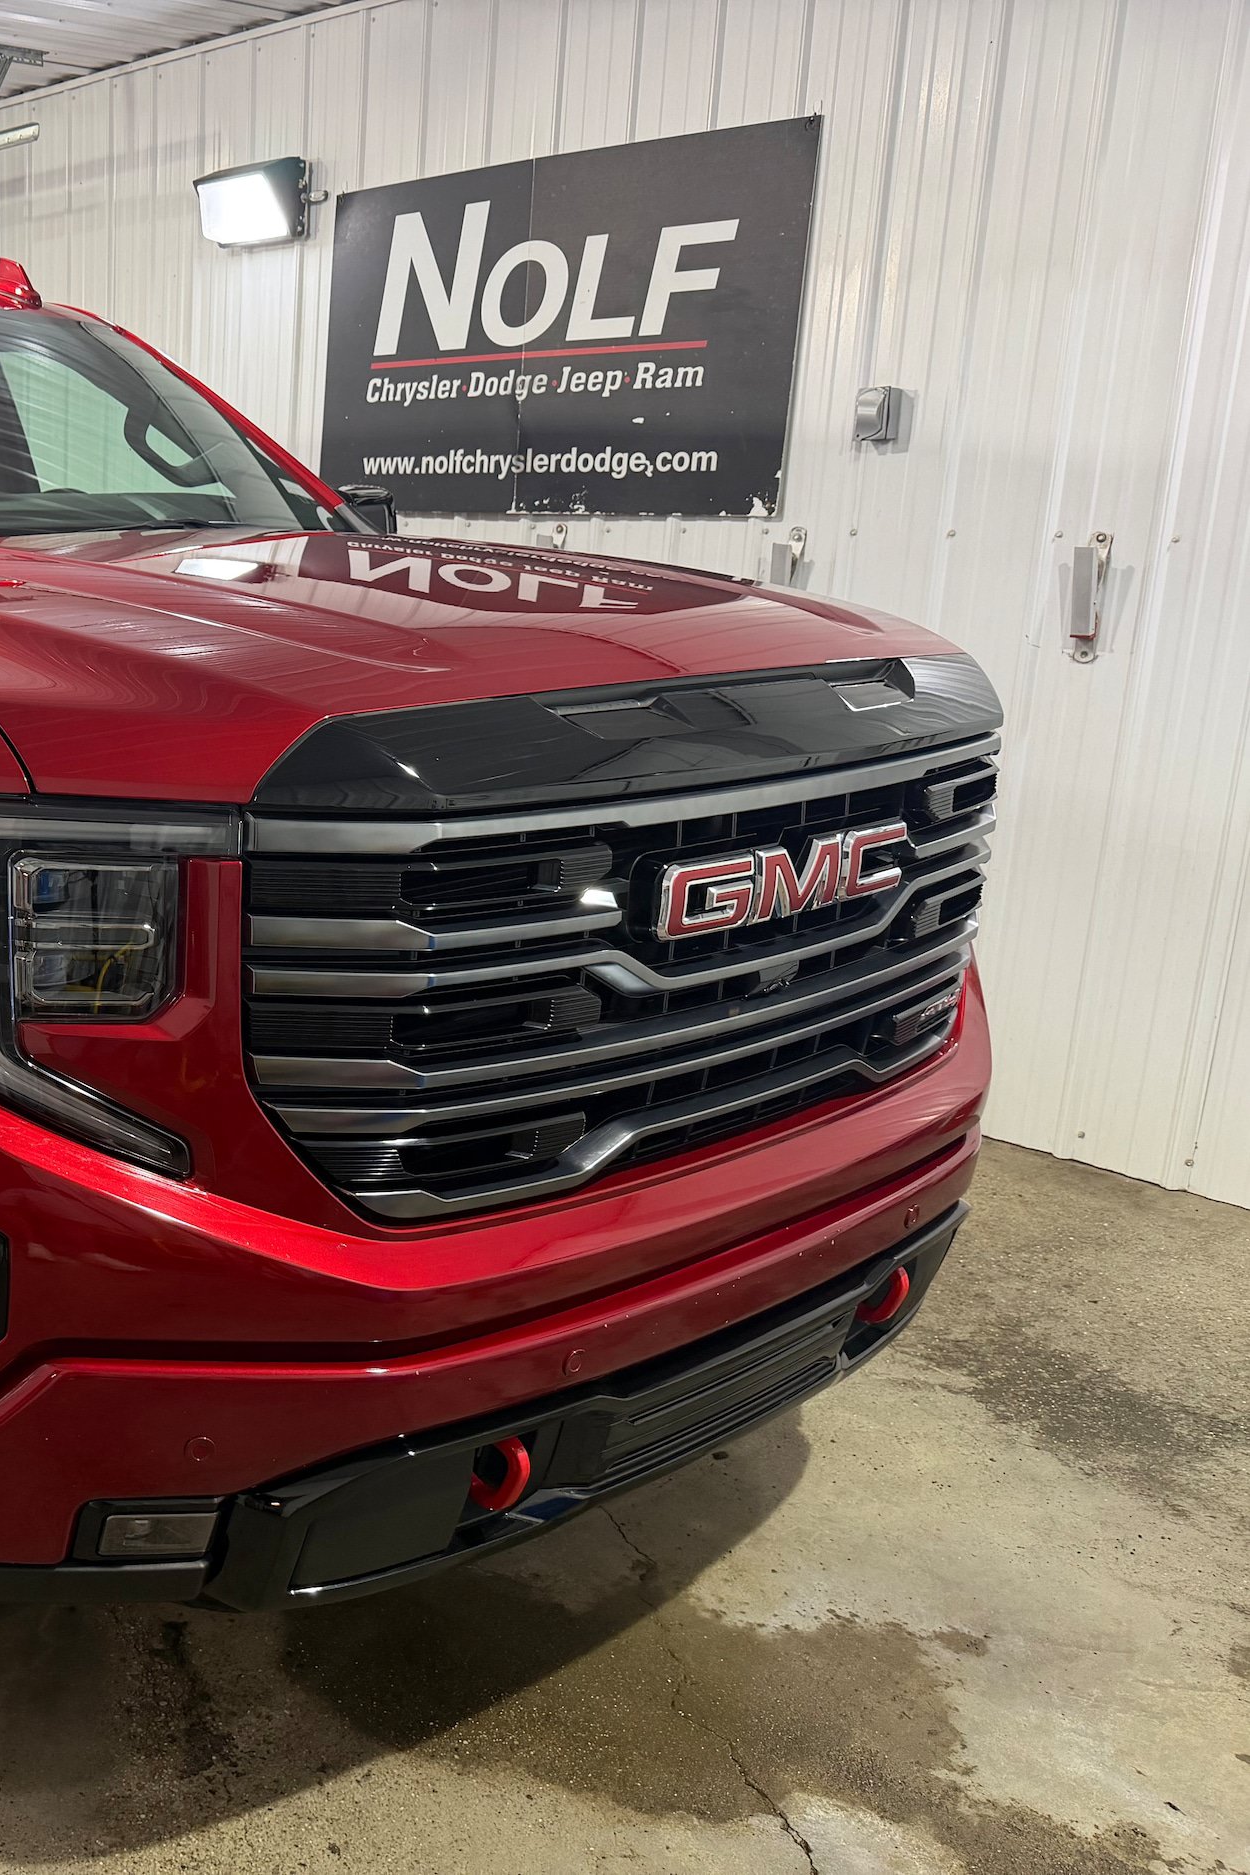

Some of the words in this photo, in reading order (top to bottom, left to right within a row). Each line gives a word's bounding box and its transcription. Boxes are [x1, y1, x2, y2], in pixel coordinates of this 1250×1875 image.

[372, 199, 741, 358] NOLF
[366, 375, 462, 407] Chrysler
[467, 370, 549, 404] Dodge
[557, 366, 623, 398] Jeep
[632, 361, 705, 391] Ram
[362, 447, 719, 480] www.nolfchryslerdodge.com
[656, 822, 907, 941] GMC
